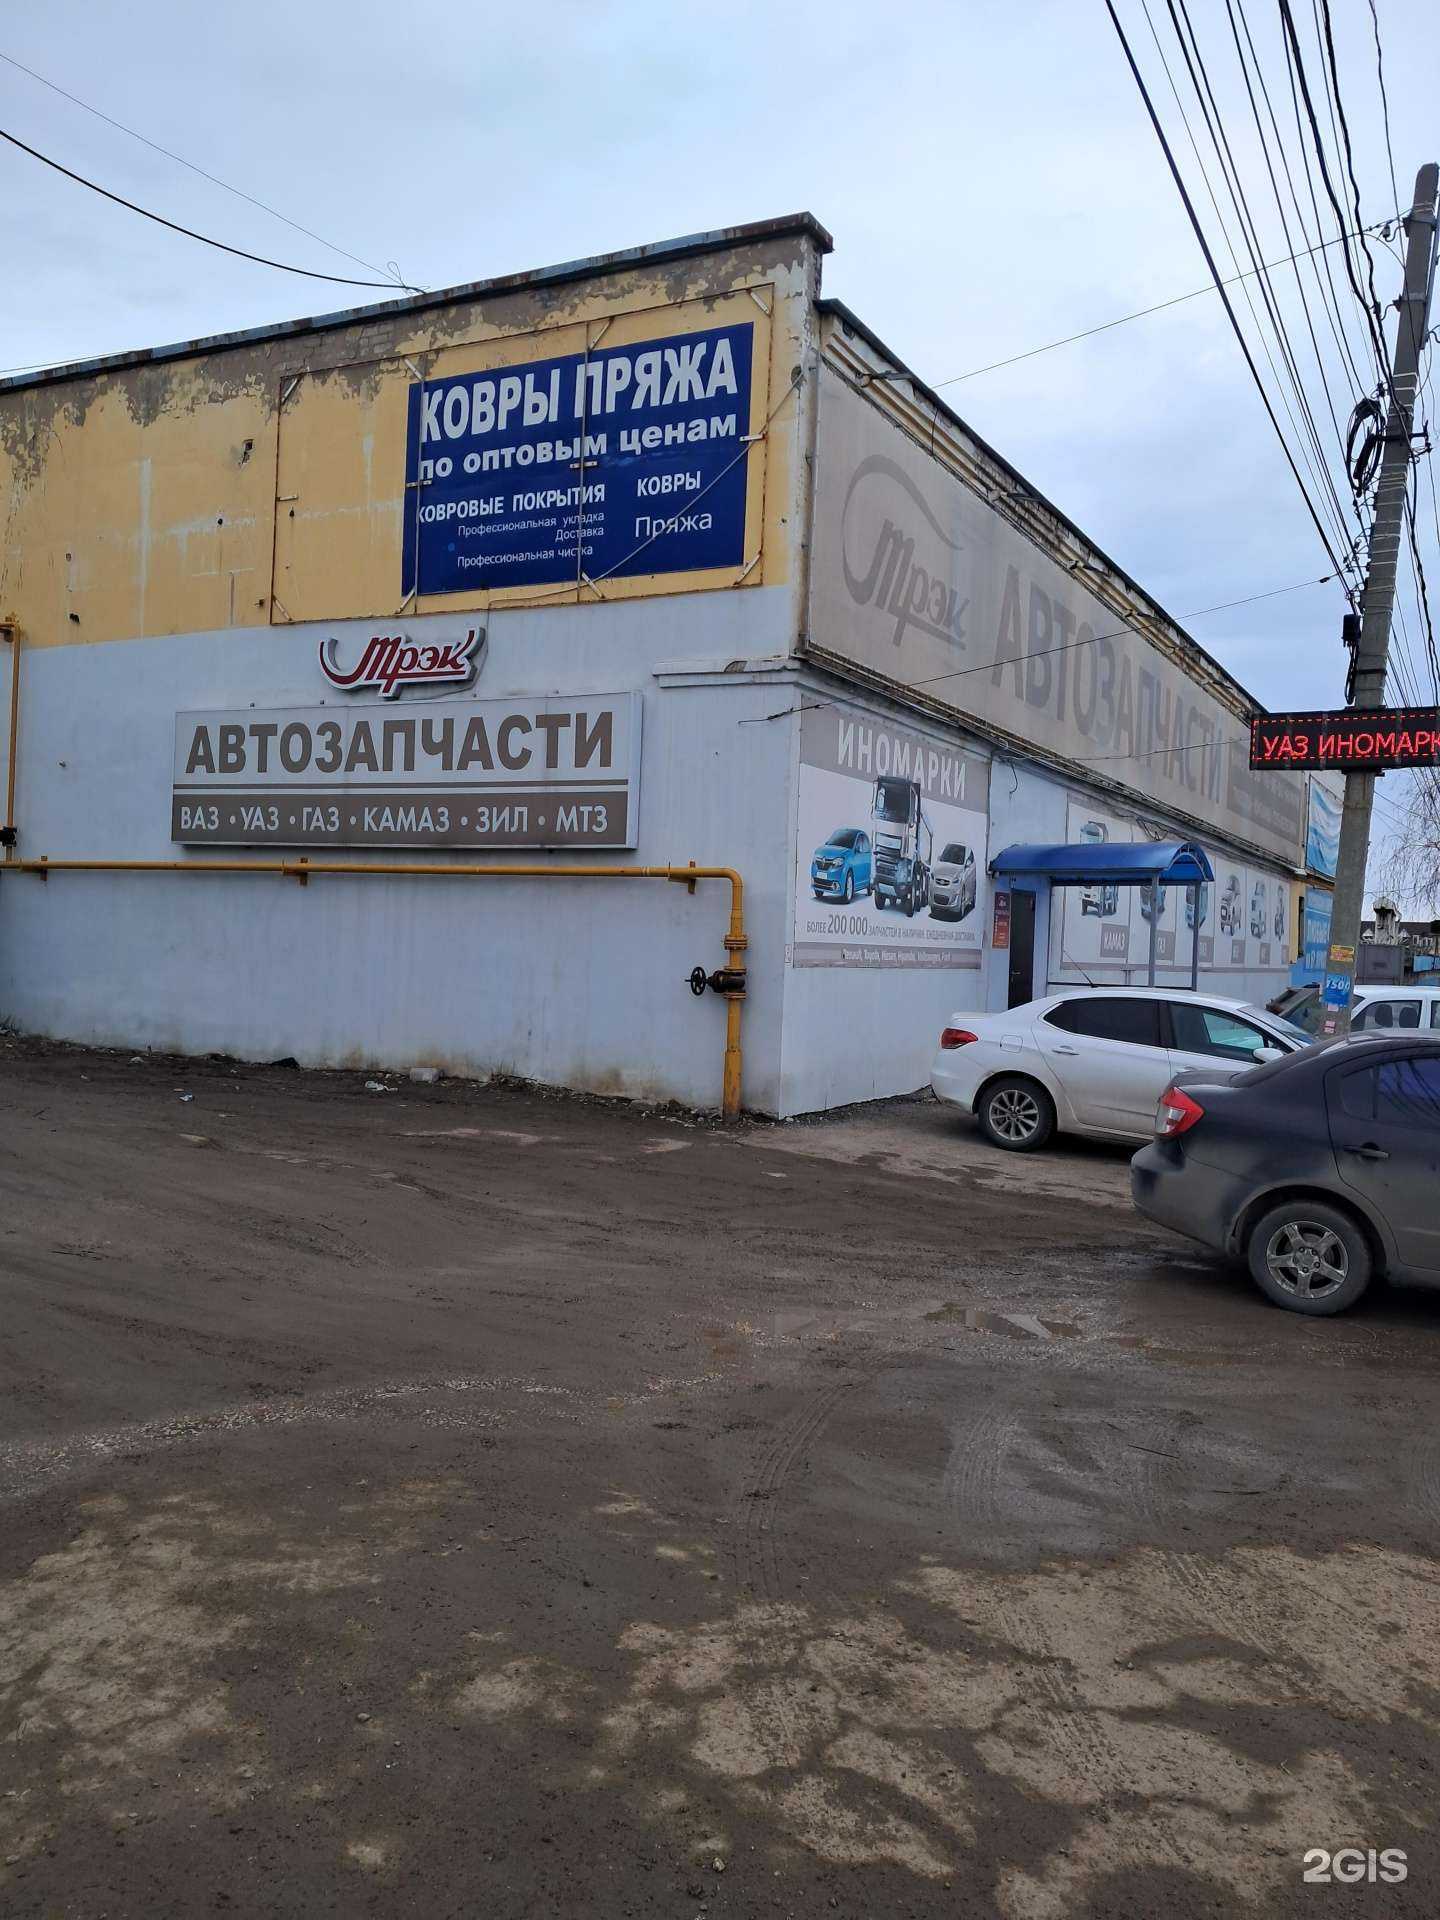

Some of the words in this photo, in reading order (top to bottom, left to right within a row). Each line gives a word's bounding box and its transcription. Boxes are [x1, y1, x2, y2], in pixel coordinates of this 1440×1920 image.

[422, 368, 560, 442] КОВРЫ
[574, 338, 737, 417] ПРЯЖА
[419, 457, 451, 480] по
[463, 432, 607, 475] оптовым
[620, 414, 736, 455] ценам
[637, 471, 701, 496] КОВРЫ
[512, 484, 605, 511] ПОКРЫТИЯ
[458, 516, 556, 537] Профессиональная
[563, 511, 604, 527] укладка
[555, 527, 604, 543] Доставка
[635, 513, 712, 541] Пряжа
[457, 549, 554, 568] Профессиональная
[558, 544, 593, 558] чистка
[185, 711, 613, 774] АВТОЗАПЧАСТИ
[1263, 735, 1308, 757] УАЗ
[836, 718, 967, 801] ИНОМАРКИ
[180, 807, 219, 831] ВАЗ
[240, 807, 280, 832] УАЗ
[302, 806, 340, 832] ГАЗ
[363, 806, 450, 832] КАМАЗ
[475, 807, 528, 833] ЗИЛ
[556, 805, 608, 833] МТЗ
[806, 920, 827, 934] БОЛЕЕ
[828, 914, 847, 934] 200
[850, 916, 868, 936] 000
